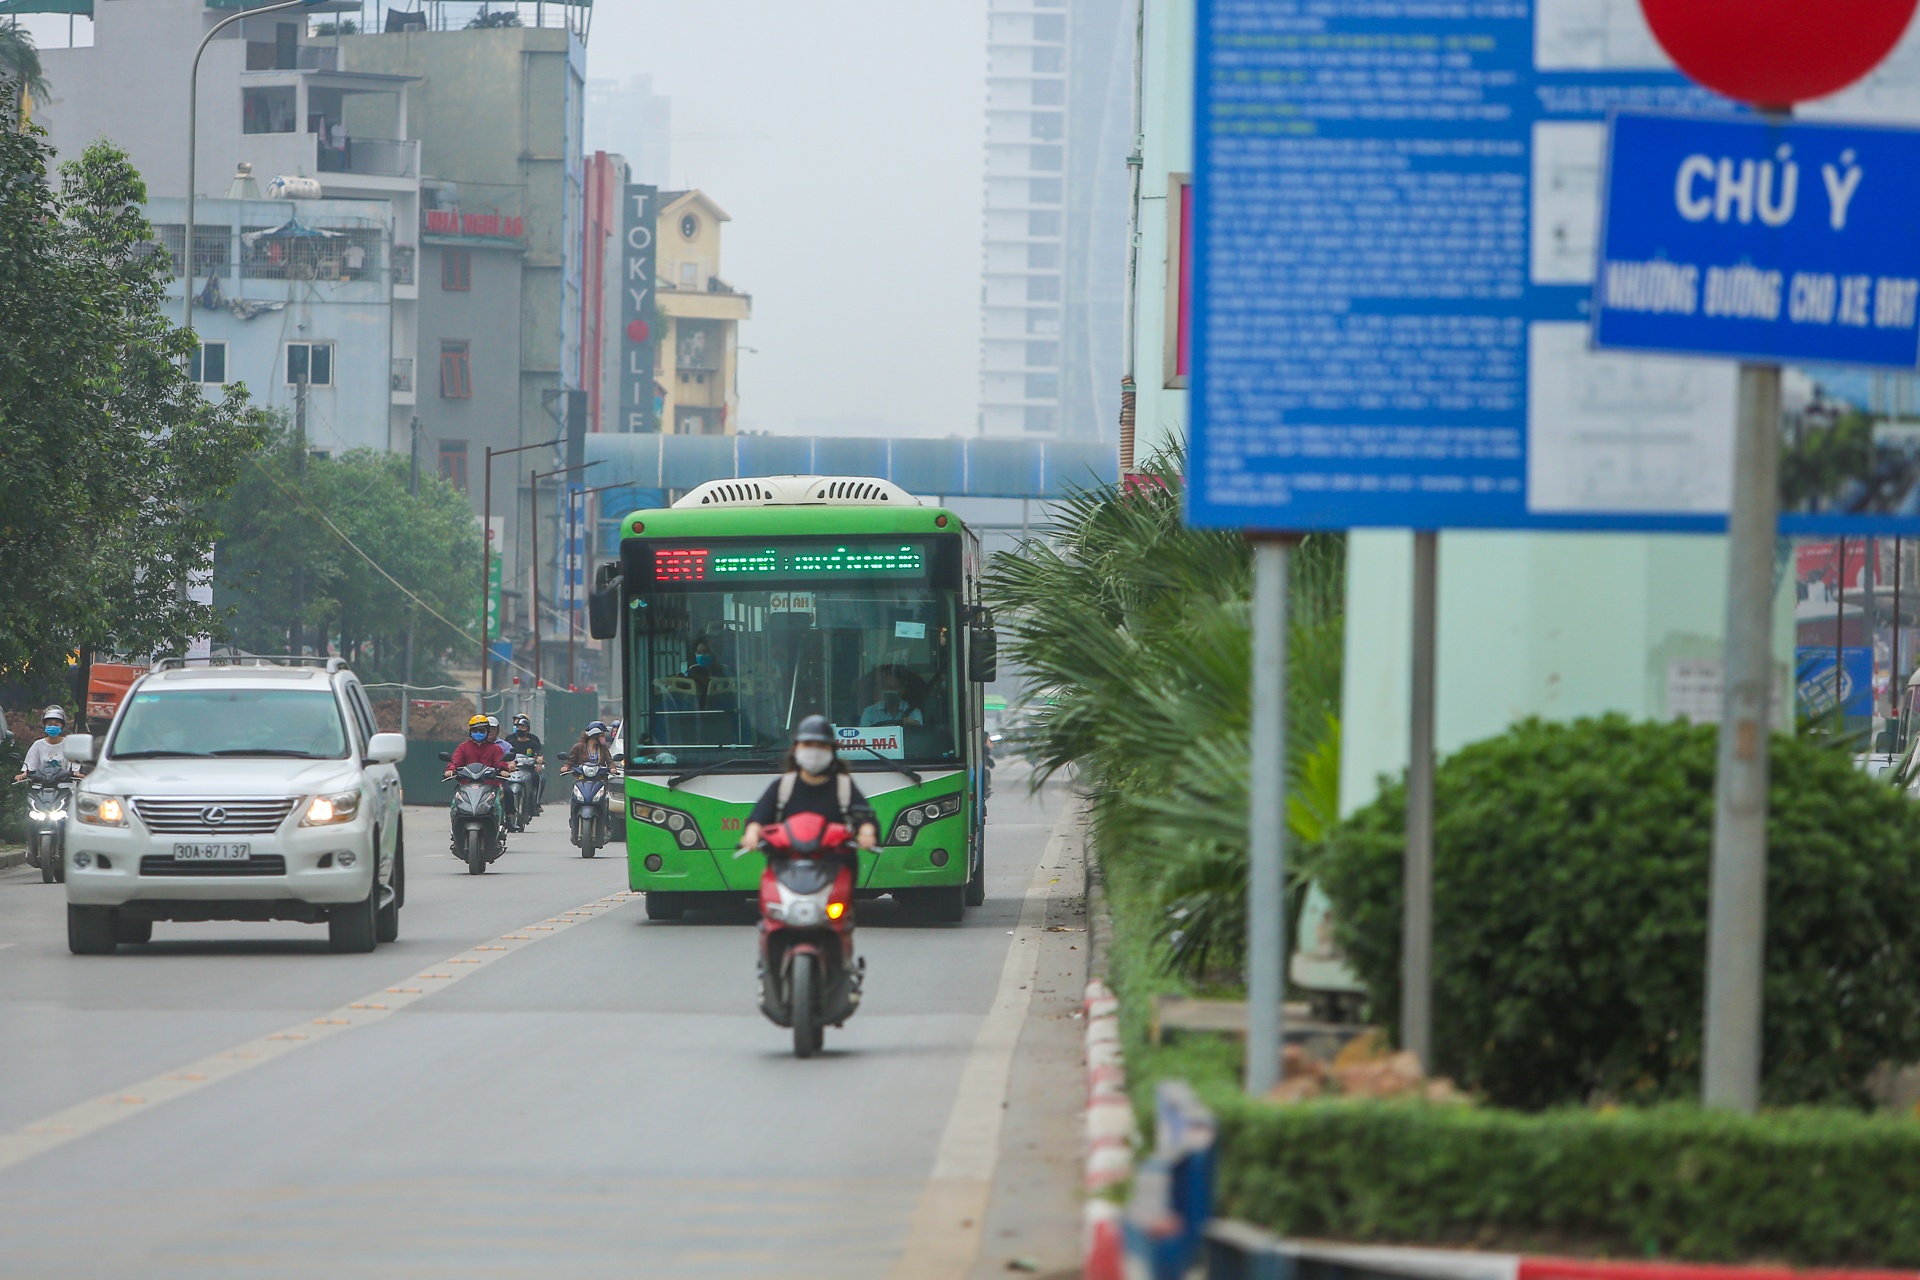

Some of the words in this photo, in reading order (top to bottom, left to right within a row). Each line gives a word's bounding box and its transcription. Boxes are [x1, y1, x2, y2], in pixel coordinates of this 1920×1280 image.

[1675, 143, 1799, 227] CHÚ
[1822, 148, 1863, 231] Ý
[1838, 275, 1871, 327] XE
[843, 729, 856, 737] BRT
[872, 734, 898, 750] MÃ
